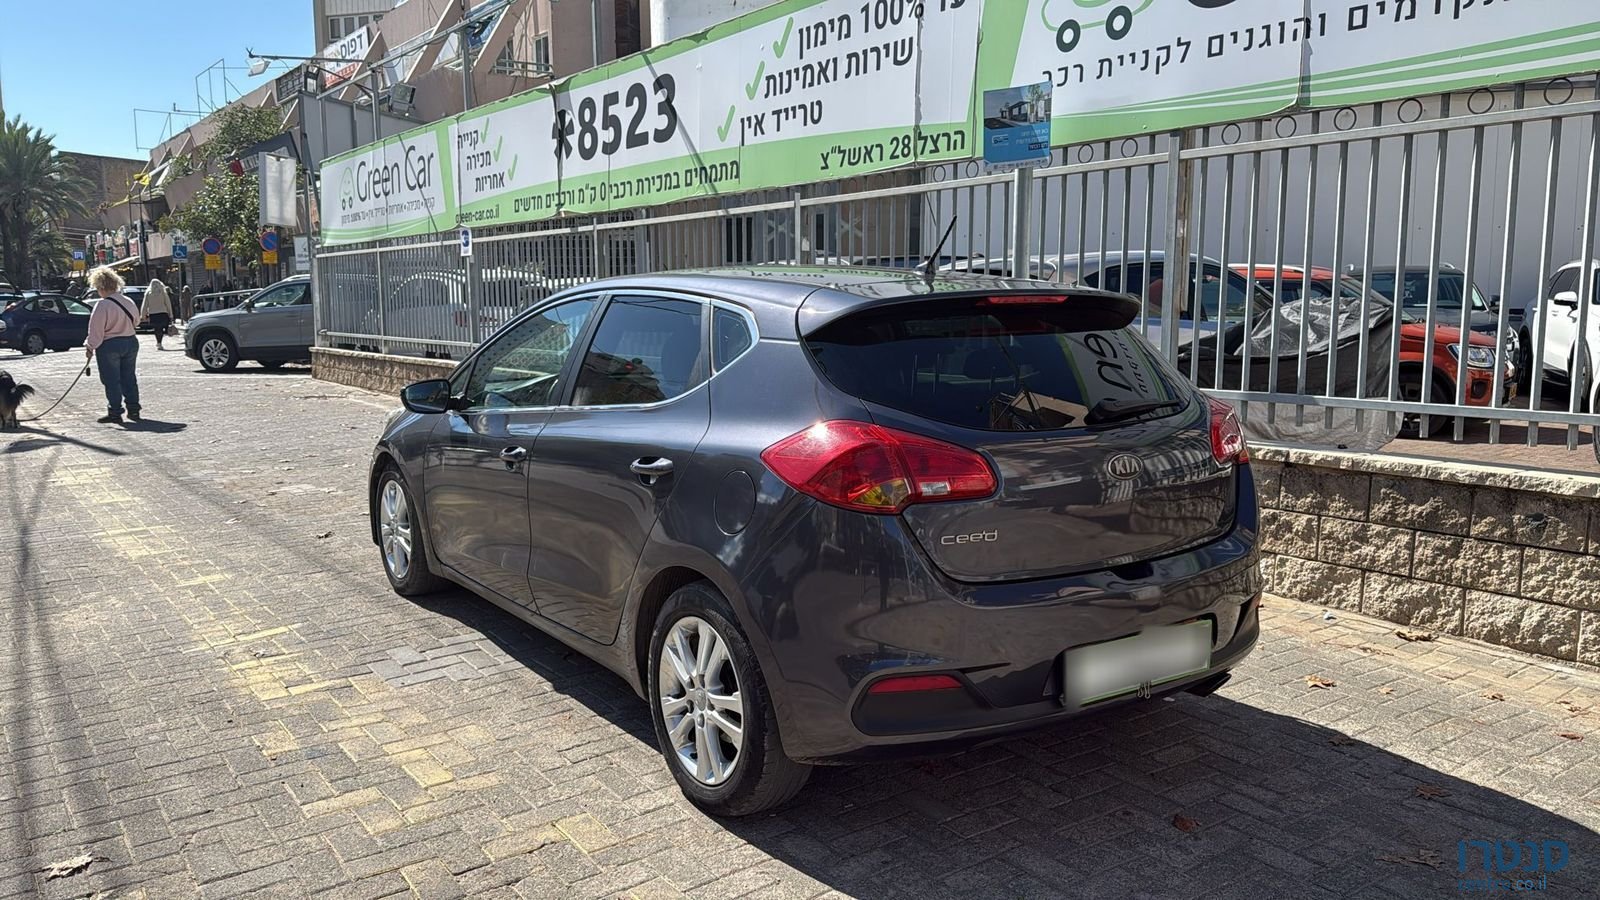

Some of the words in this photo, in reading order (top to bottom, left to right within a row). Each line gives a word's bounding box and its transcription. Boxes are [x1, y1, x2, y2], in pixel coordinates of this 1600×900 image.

[859, 0, 925, 34] 100%
[340, 33, 363, 59] דפוס
[798, 14, 852, 60] מימון
[1206, 12, 1326, 58] והוגנים
[844, 36, 914, 79] שירות
[1096, 36, 1192, 80] לקניית
[763, 57, 839, 99] ואמינות
[771, 99, 824, 132] טרייד
[457, 129, 479, 151] קנייה
[740, 112, 767, 146] אין
[889, 134, 912, 160] 28
[916, 130, 966, 156] הרצל
[466, 150, 492, 171] מכירה
[684, 159, 740, 186] מתמחים
[356, 160, 401, 203] Green
[404, 145, 435, 192] Car
[475, 171, 505, 193] אחריות
[635, 171, 681, 192] במכירת
[513, 195, 543, 213] חדשים
[544, 190, 575, 211] ורכבים
[600, 181, 607, 201] 0
[609, 182, 634, 201] רכבי
[1114, 457, 1140, 475] KIA
